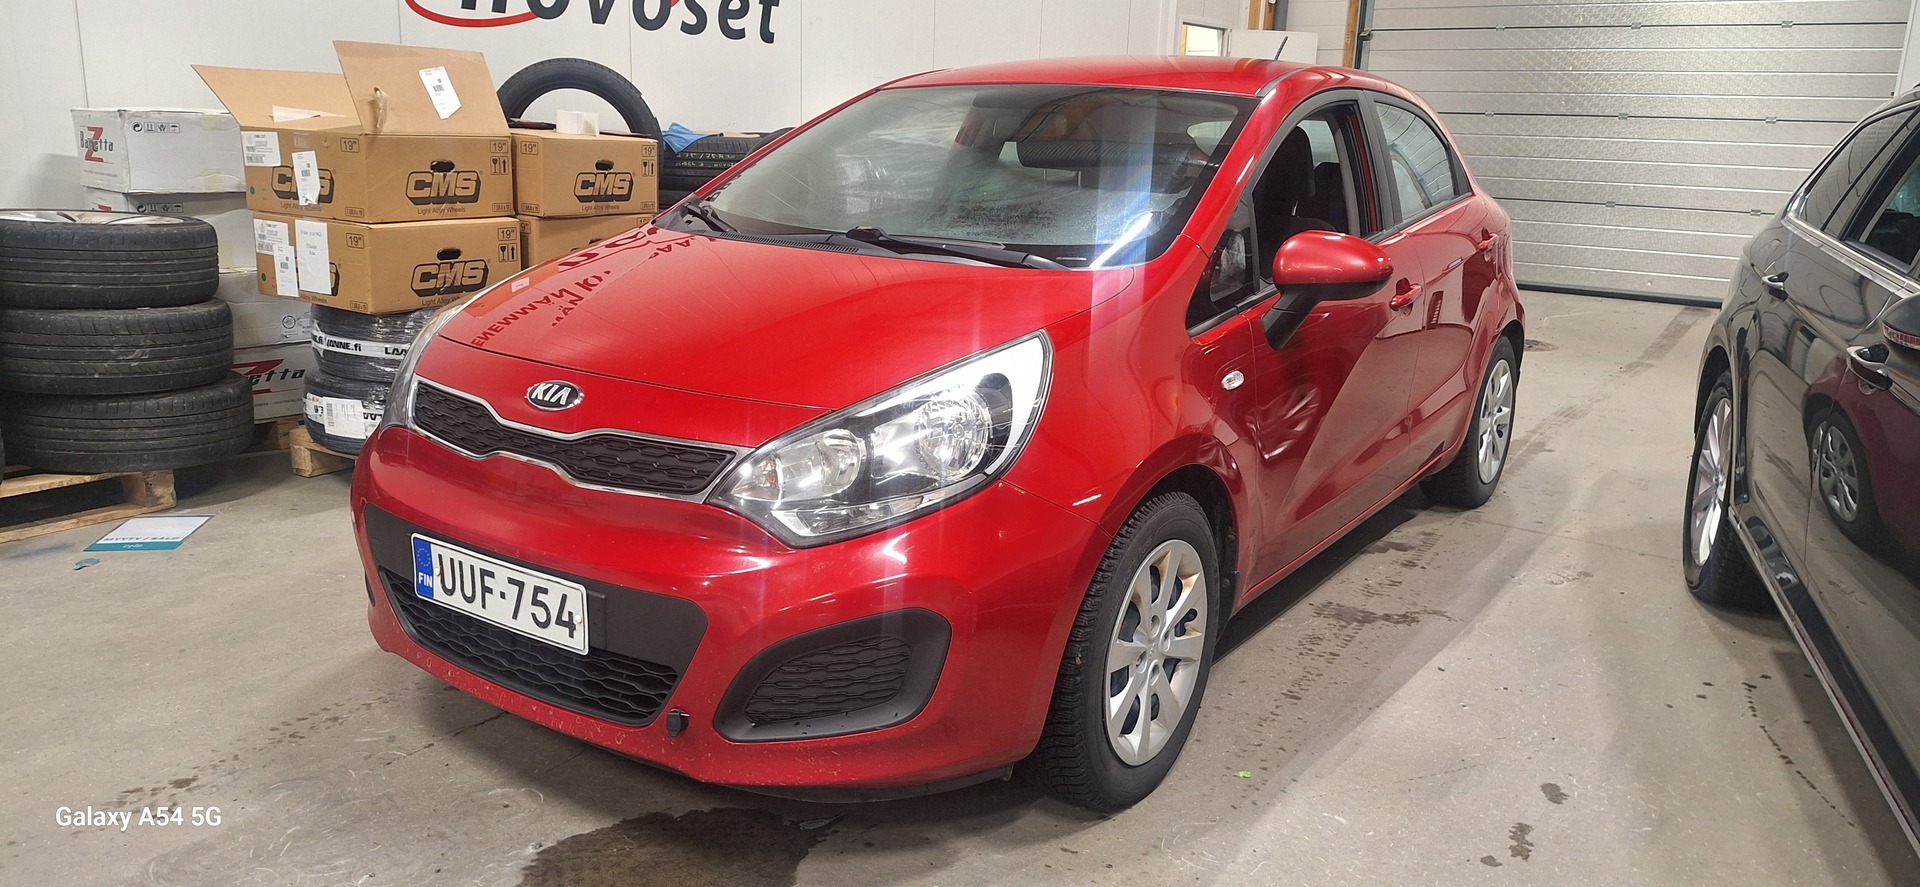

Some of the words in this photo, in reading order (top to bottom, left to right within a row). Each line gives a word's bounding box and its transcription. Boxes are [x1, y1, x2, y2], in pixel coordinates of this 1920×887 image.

[461, 0, 779, 44] voset
[343, 140, 357, 150] 19"
[492, 142, 507, 152] 19"
[523, 143, 537, 153] 19"
[643, 146, 655, 155] 19"
[271, 166, 334, 203] CS
[406, 171, 481, 205] CMS
[574, 172, 634, 203] CMS
[417, 206, 431, 215] Light
[581, 204, 592, 212] Light
[520, 222, 529, 232] 9"
[500, 229, 515, 239] 19"
[349, 236, 362, 246] 19"
[411, 259, 489, 297] CMS
[421, 298, 436, 306] Light
[531, 383, 571, 405] KIA
[418, 572, 433, 588] FIN
[438, 553, 577, 639] UUF-754
